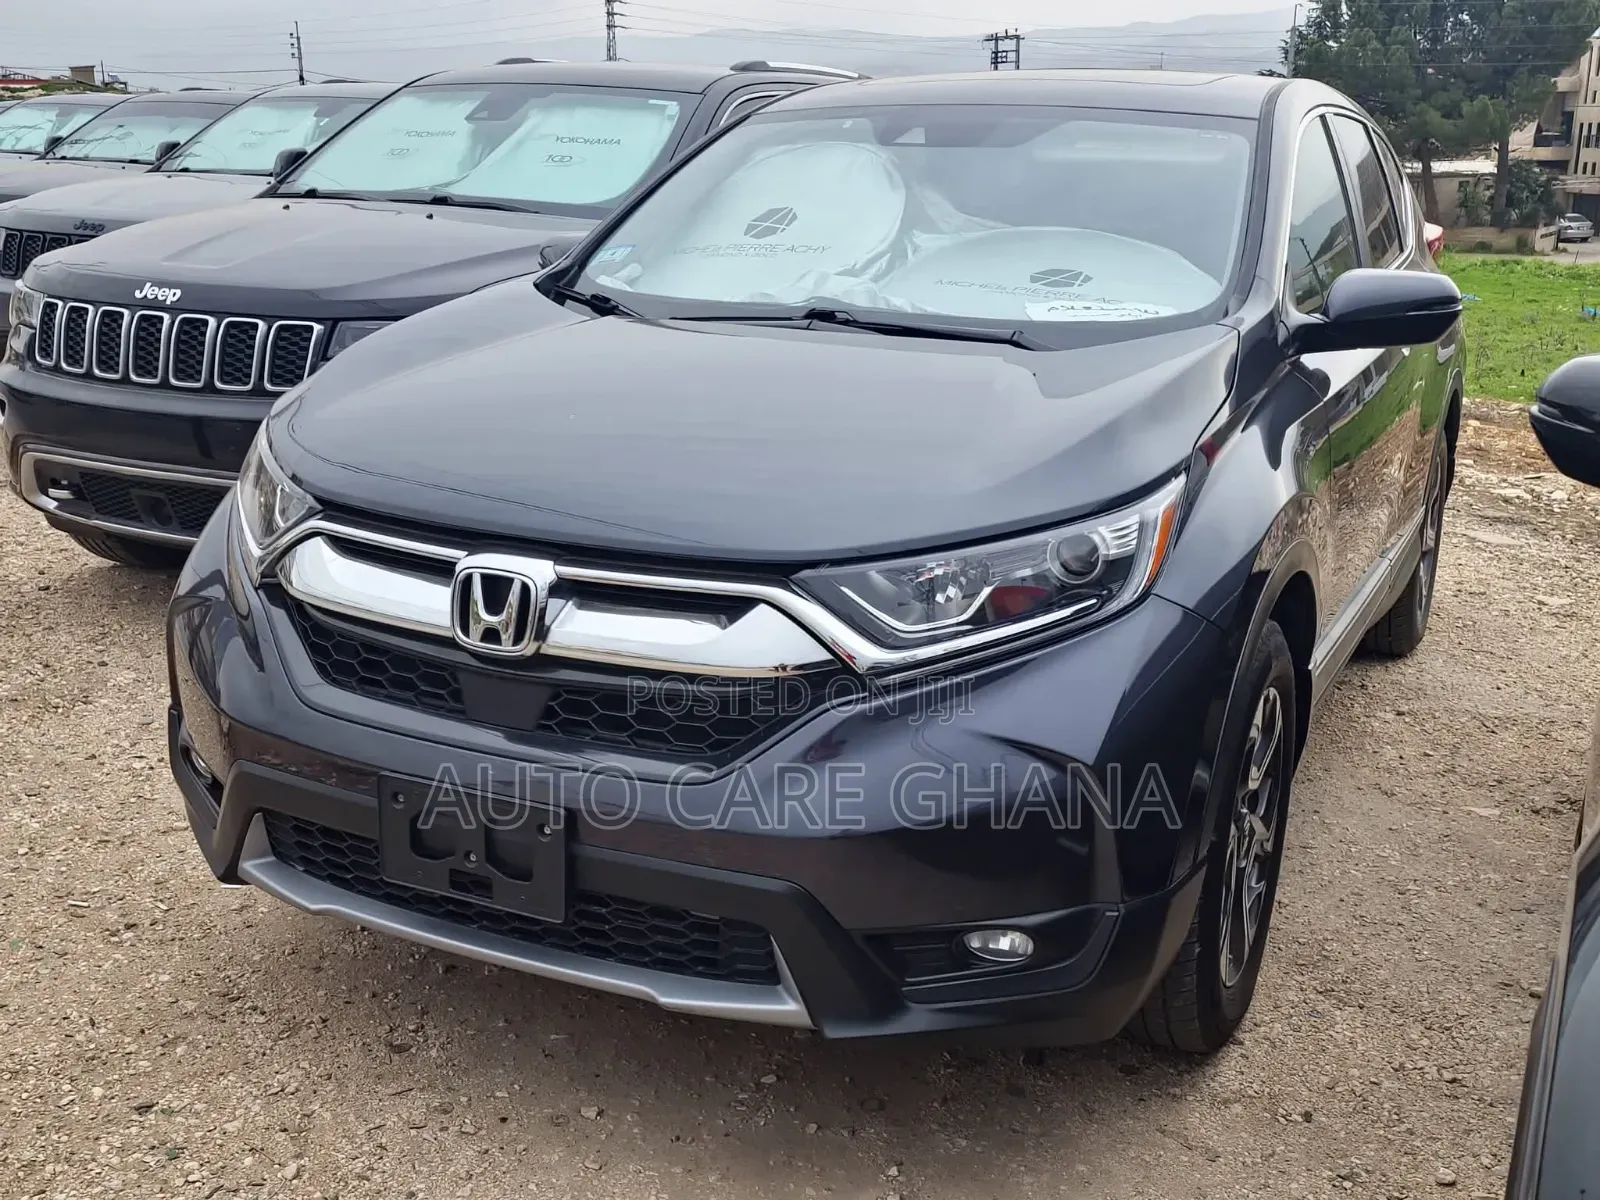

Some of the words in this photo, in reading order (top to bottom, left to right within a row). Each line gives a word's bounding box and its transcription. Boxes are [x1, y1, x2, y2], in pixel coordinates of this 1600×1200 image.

[555, 136, 621, 146] YOKOHAMA
[73, 219, 105, 233] Jeep
[722, 243, 783, 253] PIERRE
[782, 244, 832, 254] ACHY
[134, 282, 182, 305] Jeep
